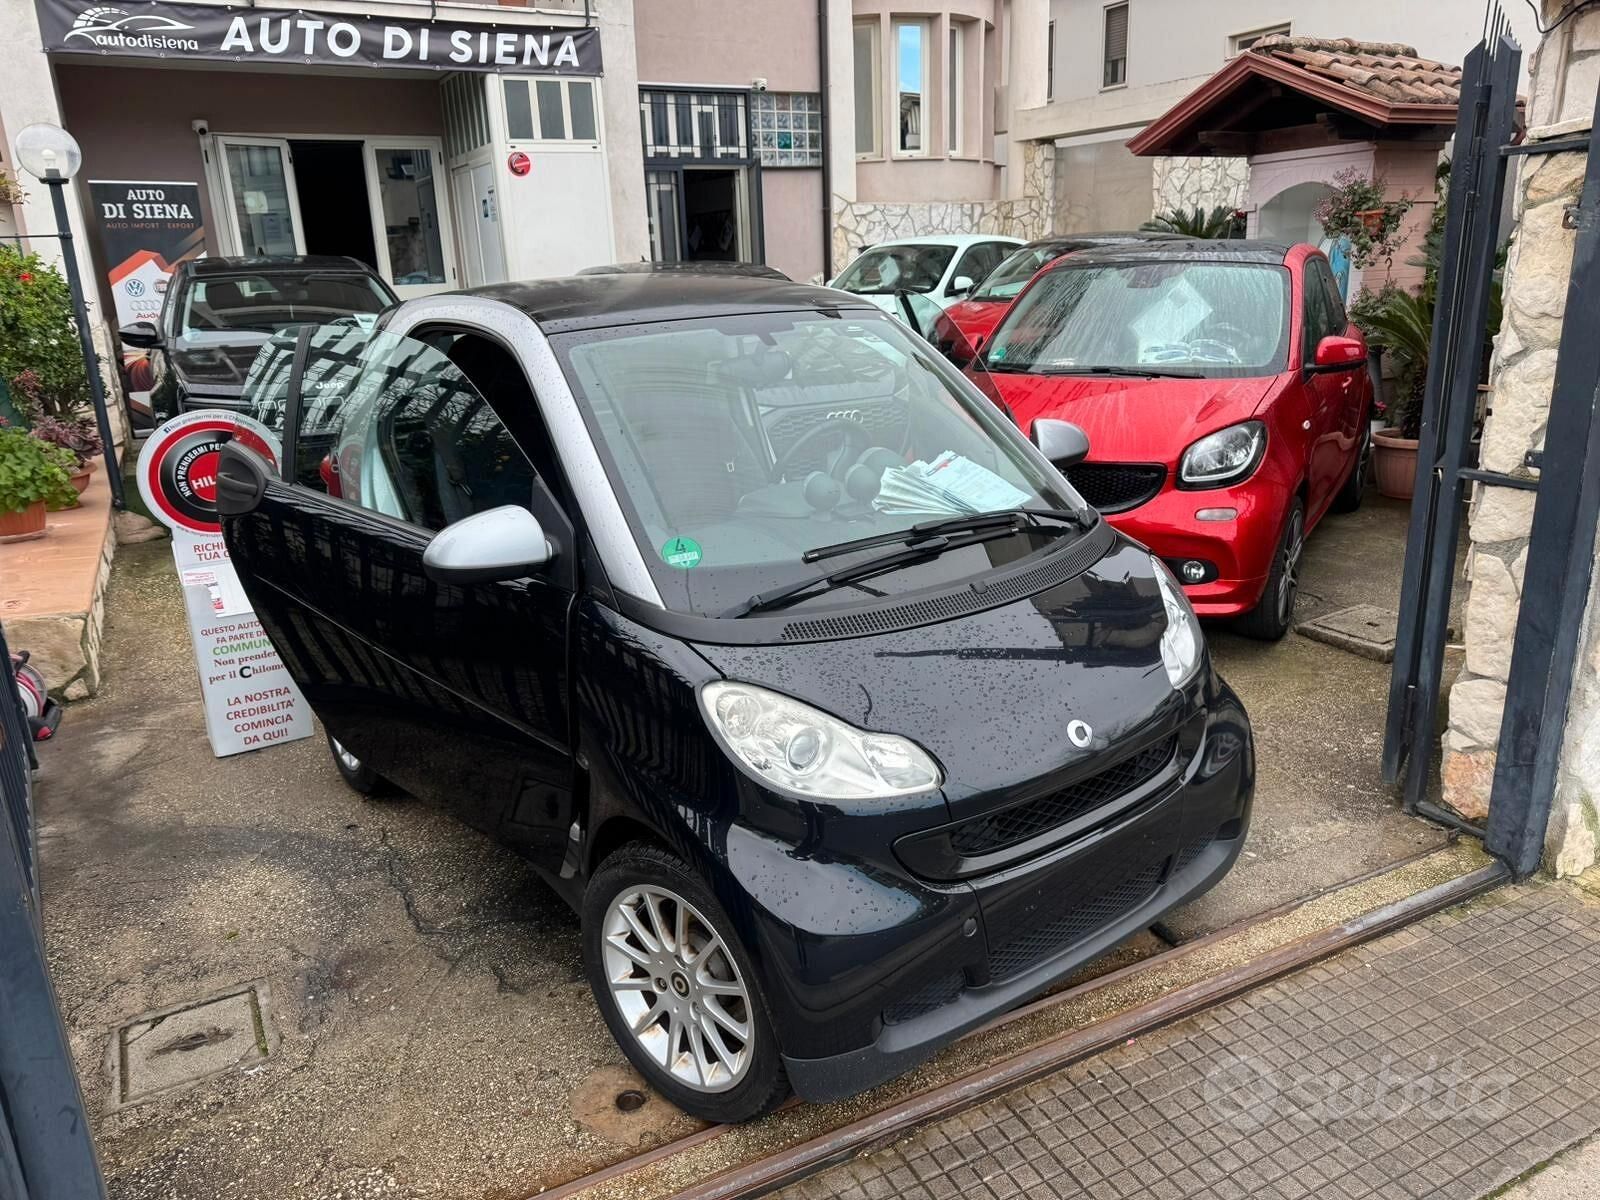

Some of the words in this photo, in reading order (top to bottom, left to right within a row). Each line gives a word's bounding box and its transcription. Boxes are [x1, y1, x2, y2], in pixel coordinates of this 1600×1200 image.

[95, 33, 198, 50] autodisiena
[220, 16, 361, 58] AUTO
[383, 26, 429, 61] DI
[449, 30, 580, 67] SIENA
[127, 189, 165, 201] AUTO
[102, 203, 126, 219] DI
[132, 203, 194, 219] SIENA
[177, 445, 208, 480] PRENDERMI
[178, 481, 193, 497] NON
[191, 475, 217, 490] HIL
[193, 542, 227, 553] RICHI
[675, 538, 687, 553] 4
[197, 551, 221, 561] TUA
[200, 624, 236, 636] QUESTO
[229, 632, 255, 642] PARTE
[214, 658, 236, 667] Non
[208, 674, 227, 685] per
[228, 670, 237, 679] il
[227, 696, 242, 706] LA
[244, 686, 291, 703] NOSTRA
[226, 697, 295, 720] CREDIBILITA'
[234, 713, 294, 733] COMINCIA
[243, 734, 260, 745] DA
[262, 727, 288, 741] QUI!
